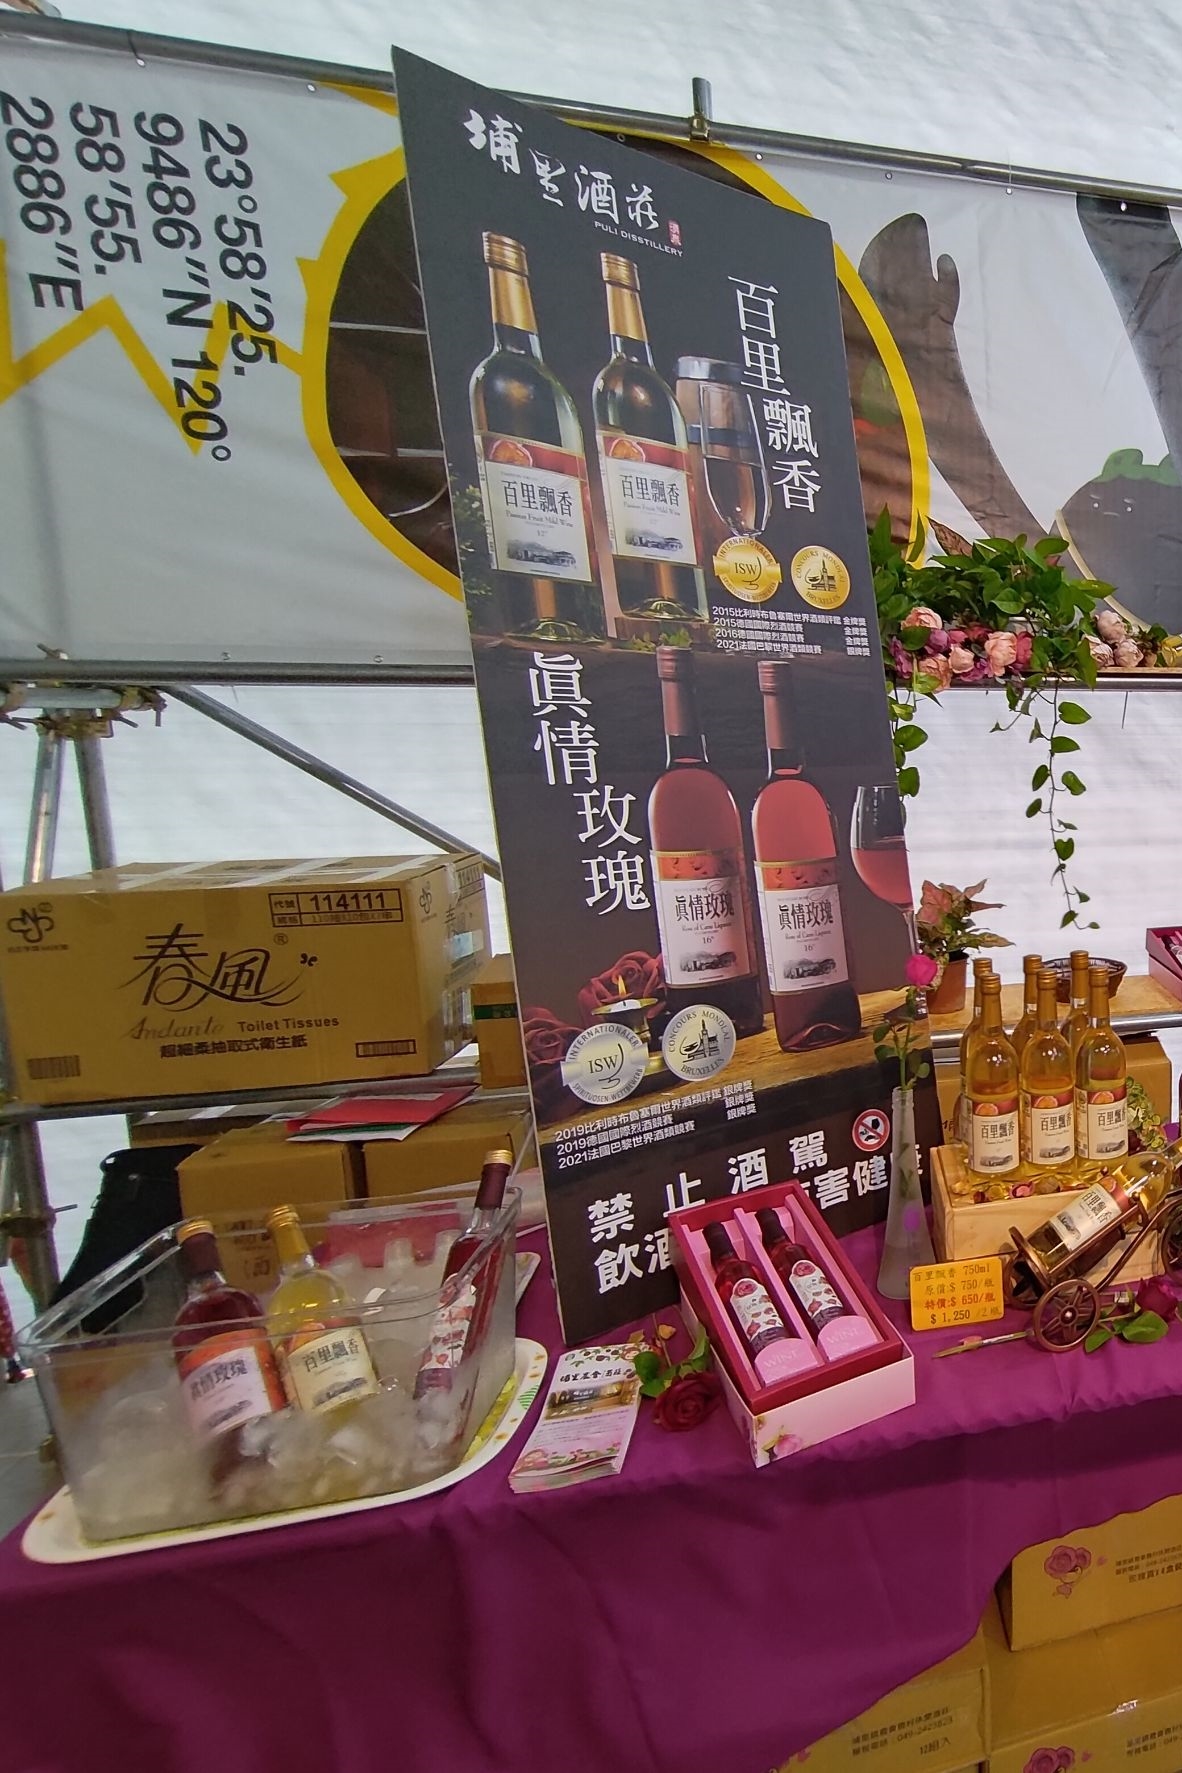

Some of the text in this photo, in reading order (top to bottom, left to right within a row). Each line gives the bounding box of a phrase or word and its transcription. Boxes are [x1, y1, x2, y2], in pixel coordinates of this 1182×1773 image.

[594, 220, 618, 236] PULI
[726, 275, 823, 513] 百里飄香
[501, 478, 574, 519] 百里飄香
[619, 474, 681, 508] 百里飄香
[734, 561, 758, 576] ISW
[310, 892, 386, 912] 114111
[237, 1020, 280, 1033] Toilet
[282, 1015, 340, 1030] Tissues
[668, 1010, 732, 1053] CONCOURS MONDIAL
[568, 1024, 639, 1061] INTERNATIONALER
[588, 1054, 619, 1074] ISW
[962, 1263, 991, 1276] 750ml
